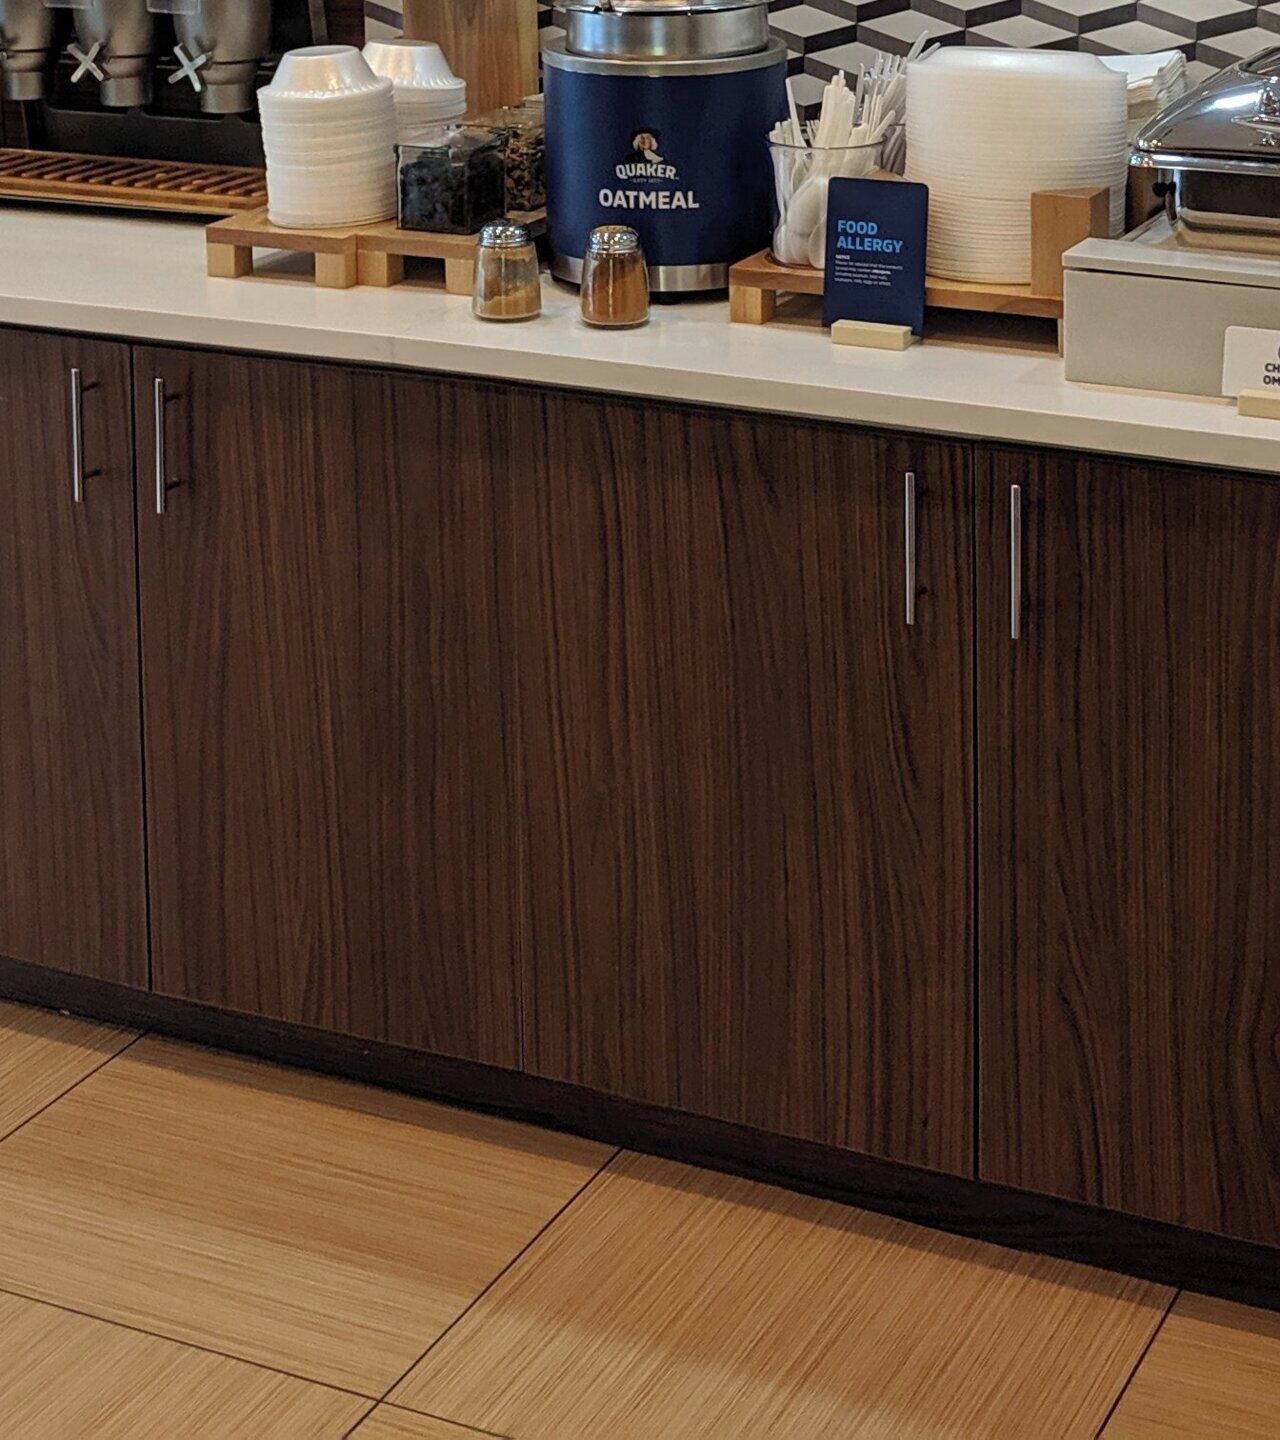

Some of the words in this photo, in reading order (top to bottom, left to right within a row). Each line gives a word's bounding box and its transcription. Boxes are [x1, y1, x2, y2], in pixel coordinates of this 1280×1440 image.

[615, 163, 677, 180] QUAKER
[598, 188, 700, 210] OATMEAL
[837, 219, 878, 236] FOOD
[835, 235, 904, 254] ALLERGY
